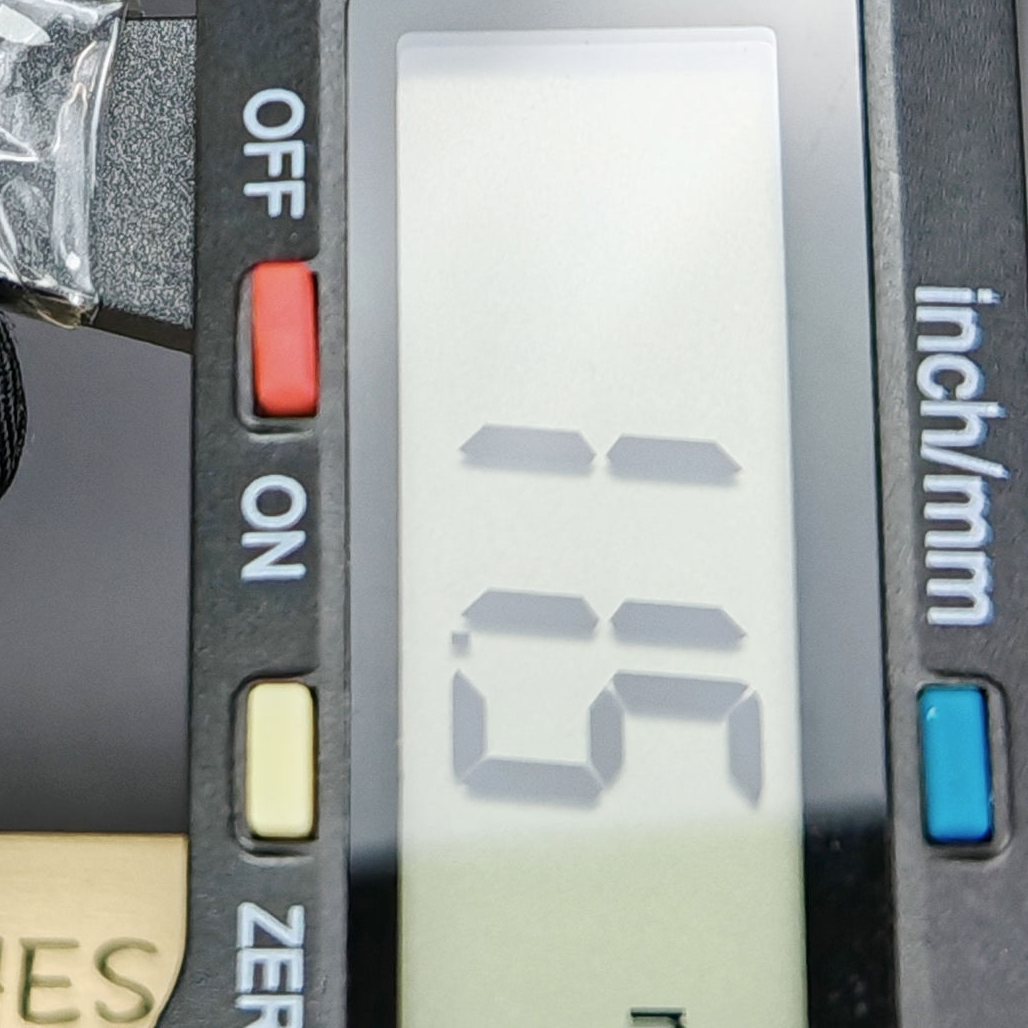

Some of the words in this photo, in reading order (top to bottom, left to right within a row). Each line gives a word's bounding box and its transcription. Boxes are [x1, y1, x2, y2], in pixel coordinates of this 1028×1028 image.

[242, 87, 305, 220] OFF
[914, 285, 1009, 628] inch/mm
[239, 473, 307, 583] ON
